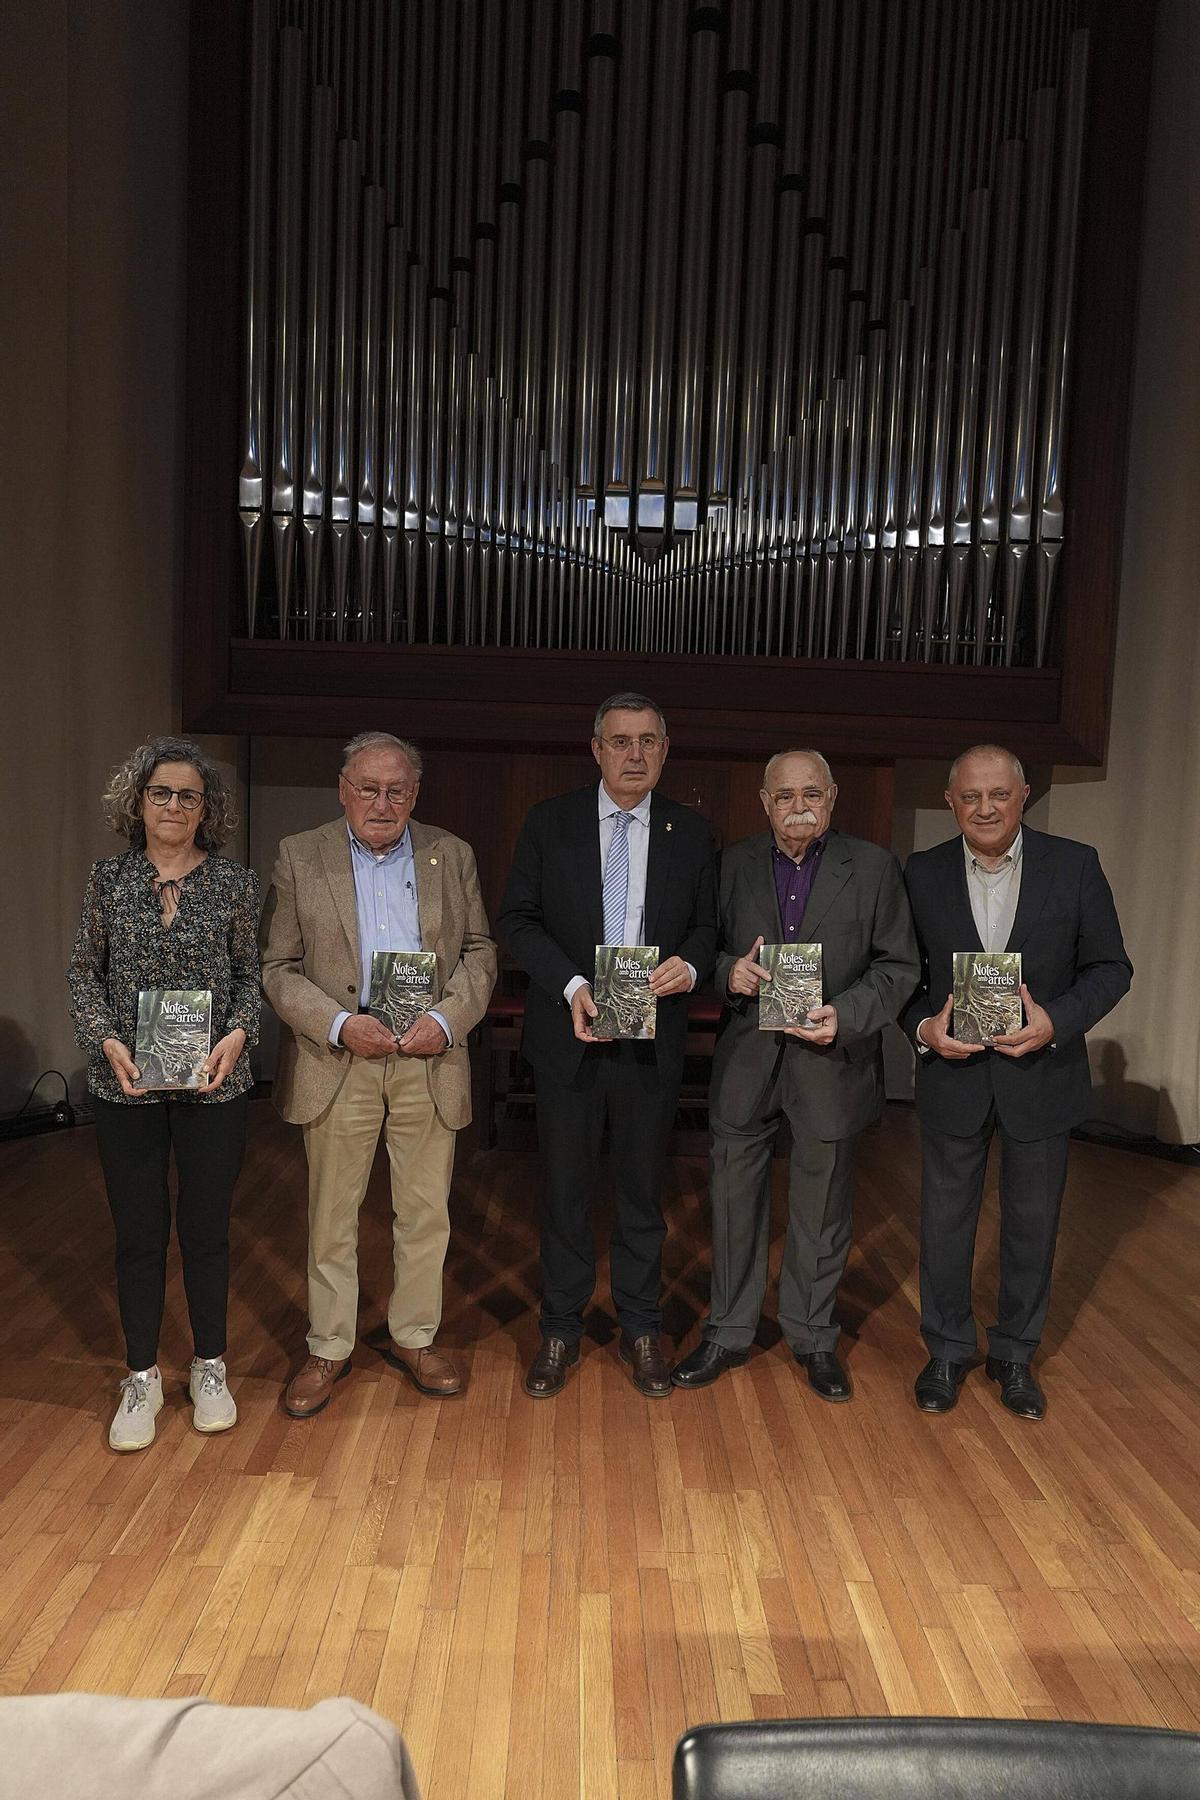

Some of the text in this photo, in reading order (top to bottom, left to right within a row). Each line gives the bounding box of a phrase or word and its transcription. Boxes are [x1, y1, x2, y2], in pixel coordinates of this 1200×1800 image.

[614, 956, 640, 971] Notes
[778, 952, 804, 966] Notes
[792, 960, 818, 972] arrels
[392, 961, 417, 976] Notes
[972, 962, 1000, 977] Notes
[405, 971, 431, 984] arrels
[988, 971, 1015, 985] arrels
[160, 1000, 190, 1015] Notes
[176, 1009, 205, 1023] arrels
